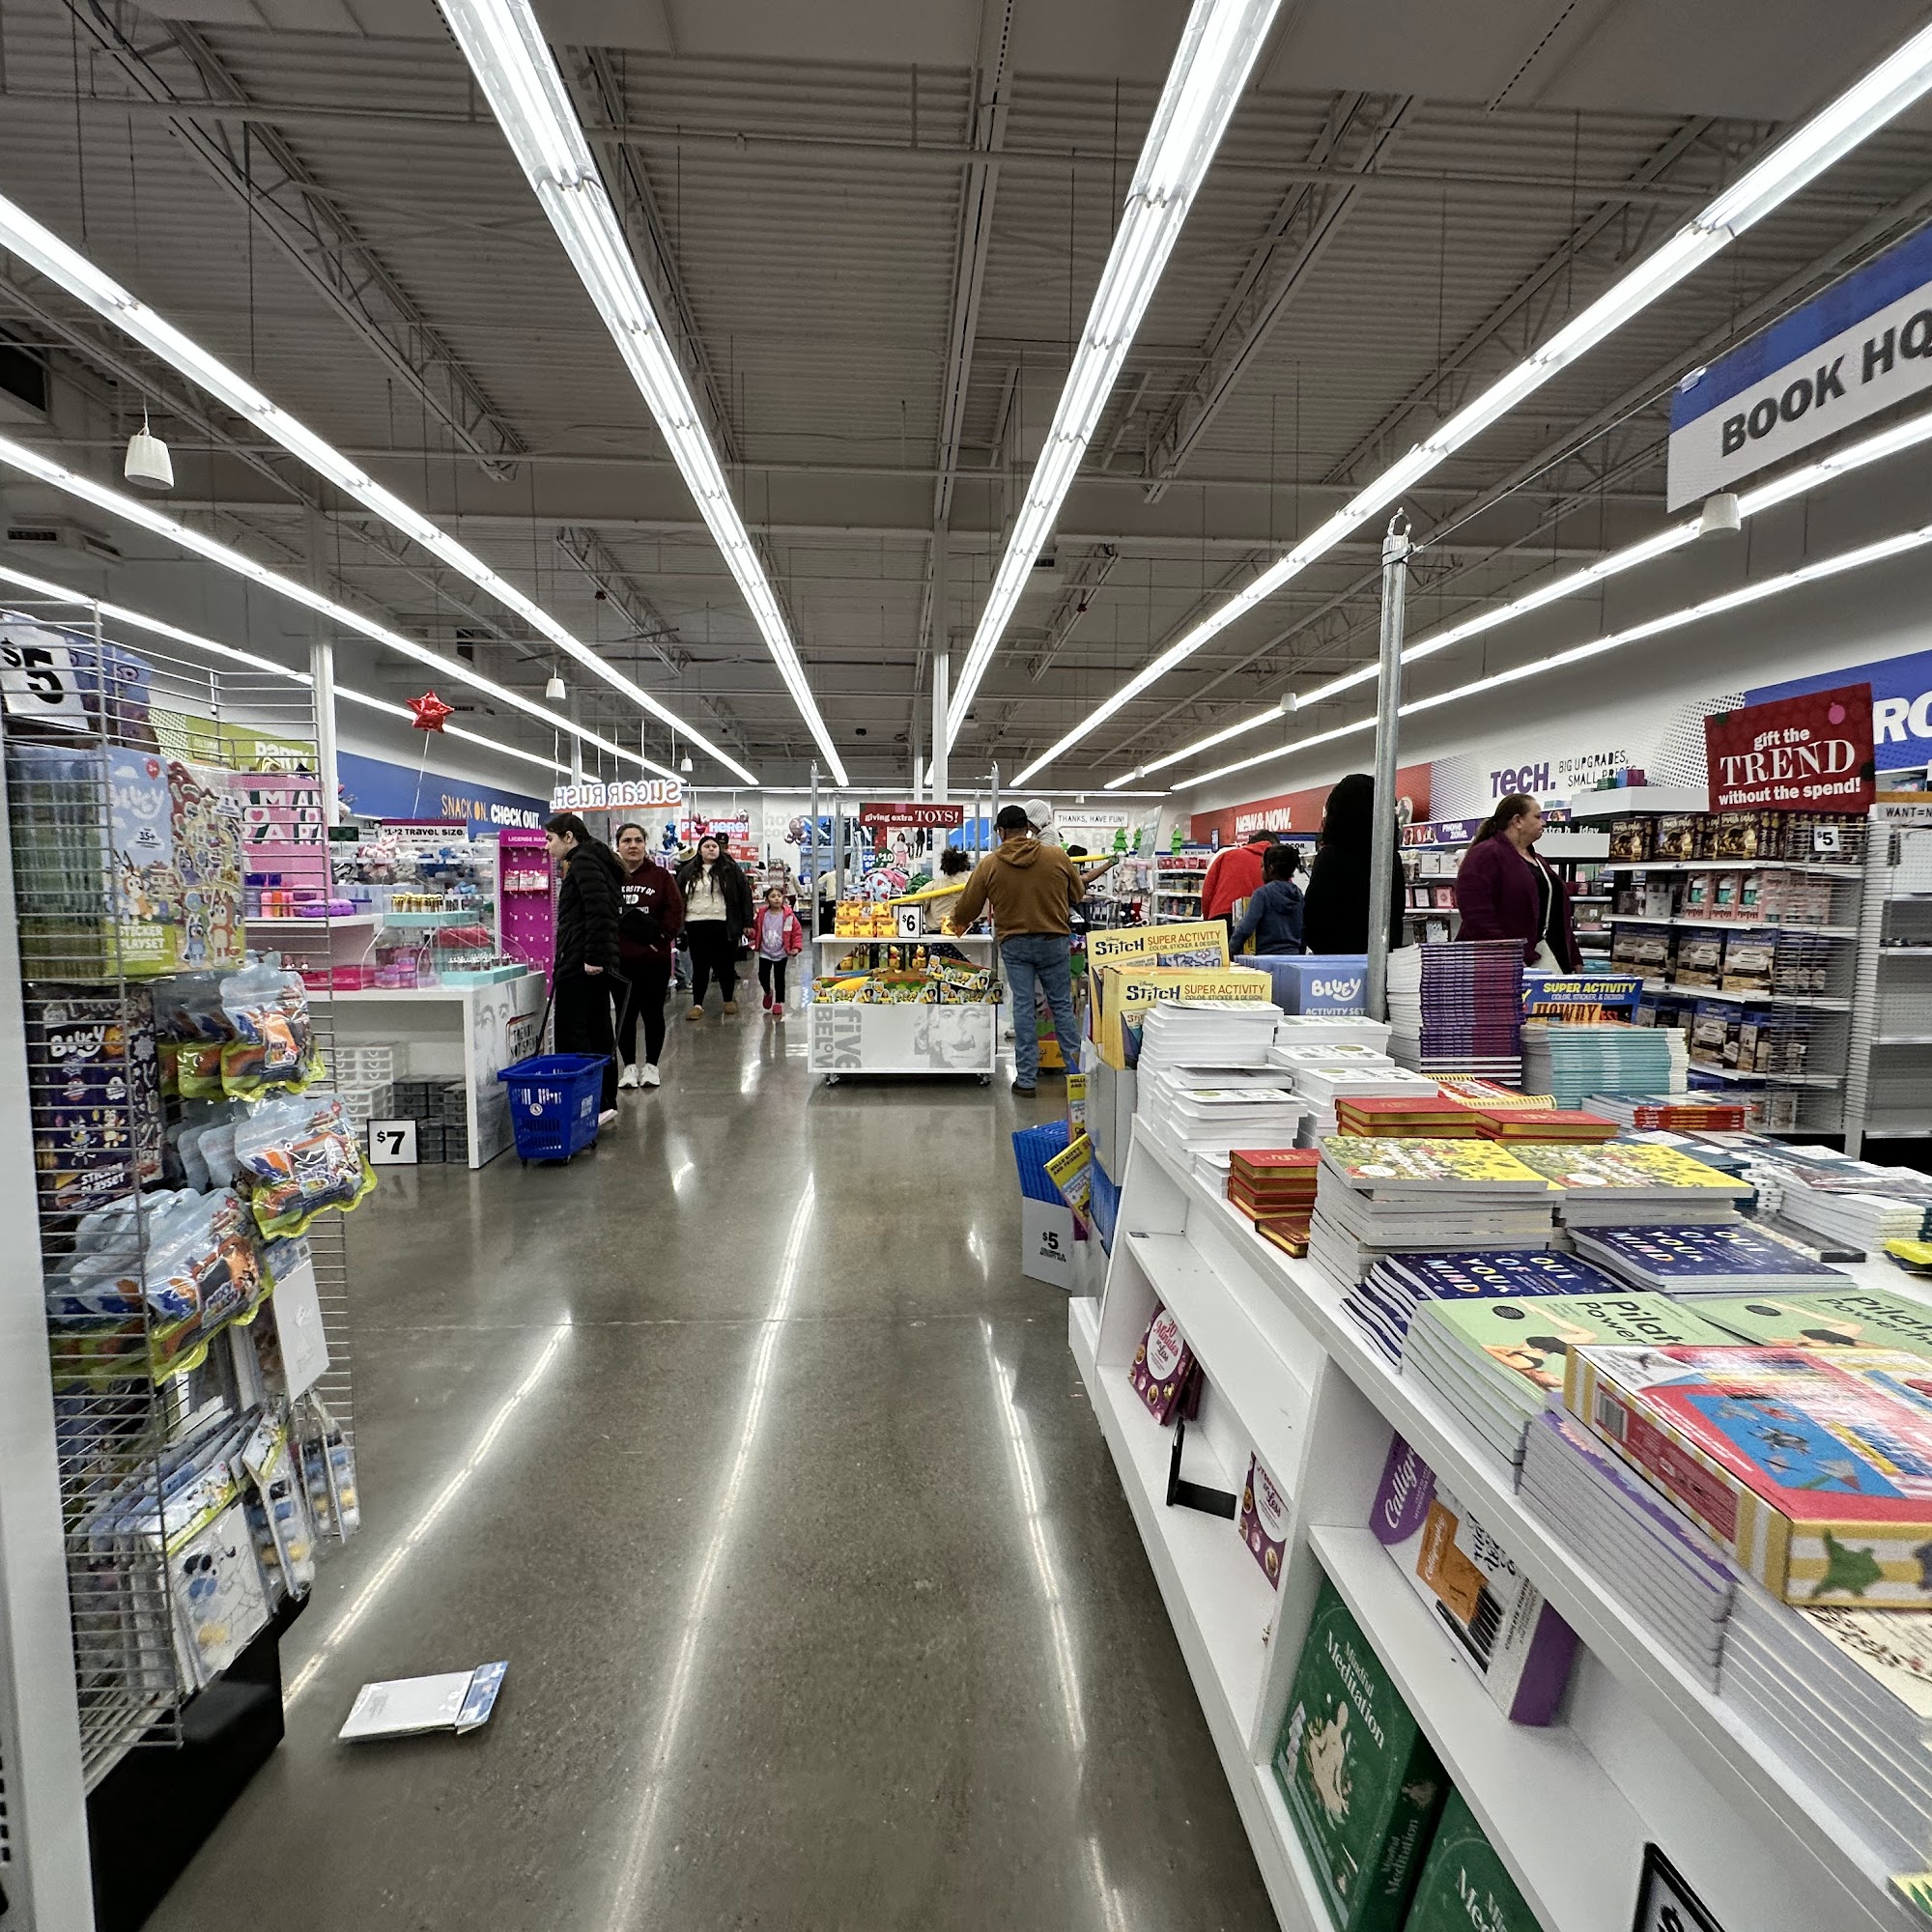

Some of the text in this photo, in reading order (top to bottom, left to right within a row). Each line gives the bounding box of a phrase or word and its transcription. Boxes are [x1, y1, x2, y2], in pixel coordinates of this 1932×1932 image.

[1721, 309, 1932, 458] BOOK HQ
[1753, 727, 1810, 752] gift the
[1559, 750, 1629, 773] BIG UPGRADES,
[1719, 739, 1856, 786] TREND
[1568, 765, 1636, 787] SMALL PRI
[1719, 777, 1861, 806] without the spend!
[440, 794, 472, 818] SNACK
[915, 810, 959, 823] TOYS!
[1257, 812, 1264, 830] &
[1817, 831, 1833, 846] $5
[902, 914, 916, 931] $6
[1148, 930, 1221, 946] SUPER ACTIVITY
[1184, 984, 1265, 994] SUPER ACTIVITY
[1543, 982, 1636, 993] SUPER ACTIVITY
[377, 1131, 406, 1154] $7
[1042, 1232, 1059, 1249] $5
[1607, 1232, 1674, 1262] MIND
[1646, 1232, 1715, 1262] YOUR
[1679, 1232, 1719, 1244] OF
[1714, 1231, 1774, 1253] OUT
[1424, 1260, 1480, 1293] MIND
[1461, 1259, 1520, 1293] YOUR
[1495, 1258, 1532, 1272] OF
[1529, 1257, 1582, 1280] OUT
[1602, 1300, 1685, 1344] Pilat
[1816, 1299, 1932, 1346] Powerh
